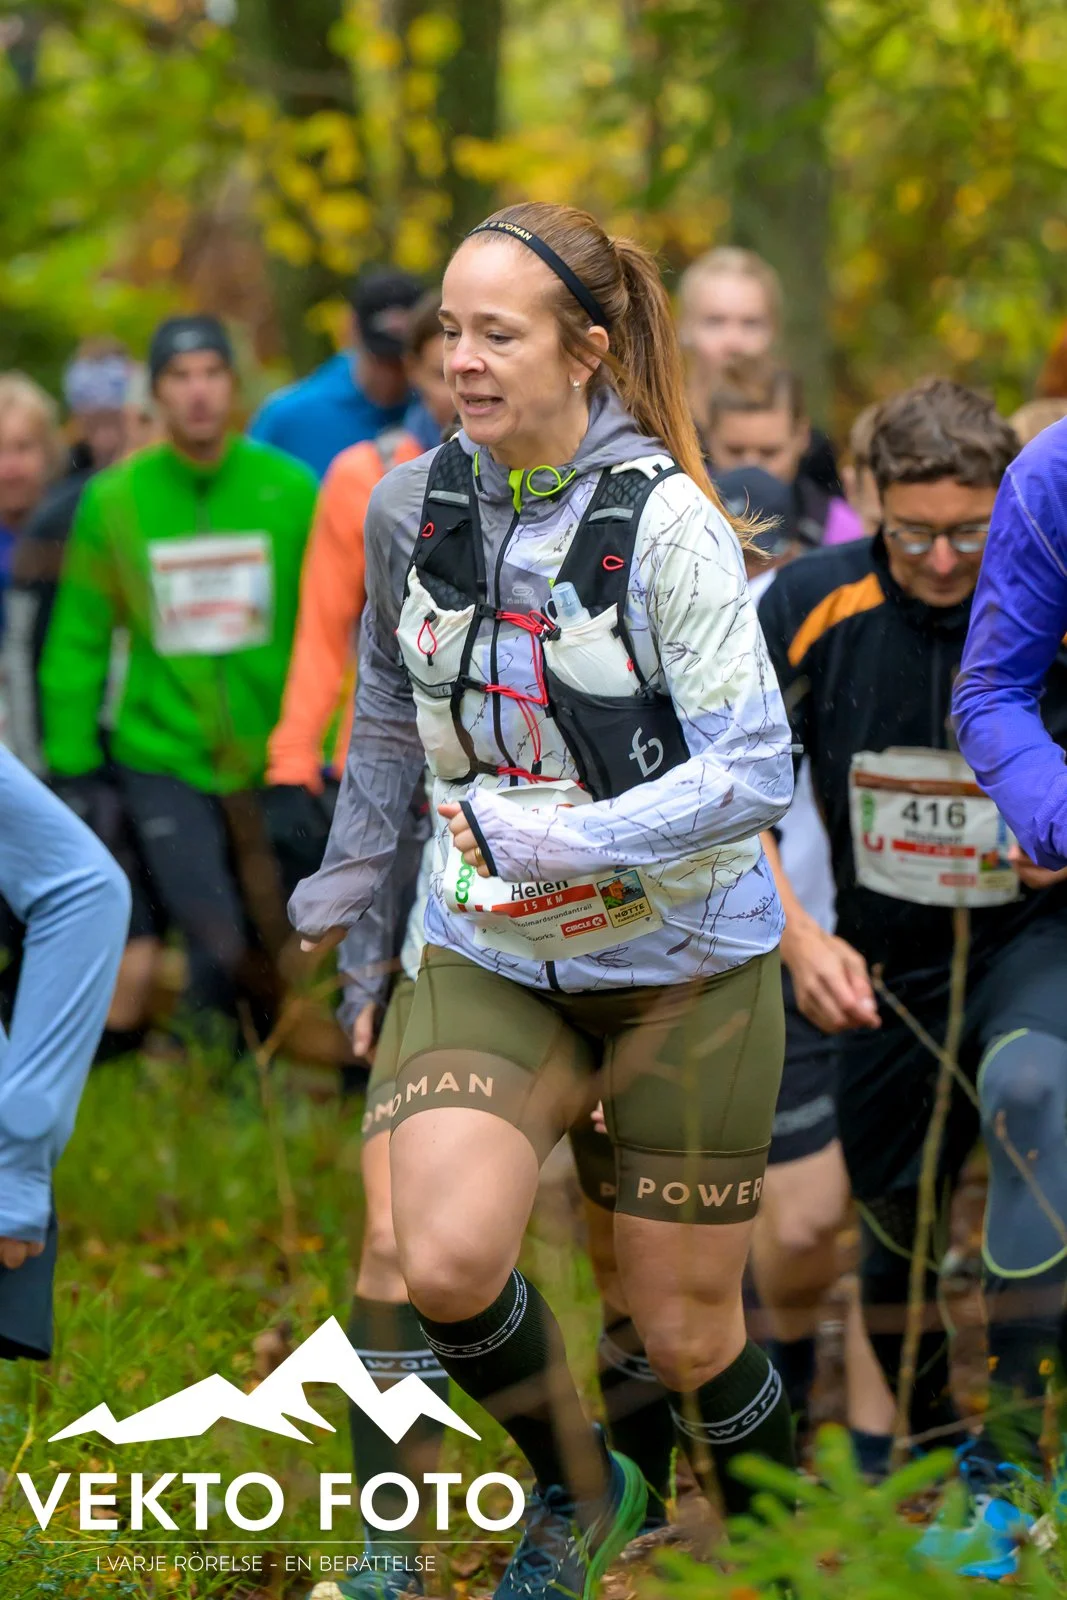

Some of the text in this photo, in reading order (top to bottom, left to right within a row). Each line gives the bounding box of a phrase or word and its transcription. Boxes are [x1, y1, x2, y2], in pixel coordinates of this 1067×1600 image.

[498, 221, 533, 241] WOMAN
[902, 800, 966, 829] 416
[511, 880, 569, 901] Helen
[546, 894, 564, 907] KM
[565, 921, 592, 933] CIRCLE
[637, 1176, 763, 1207] POWER
